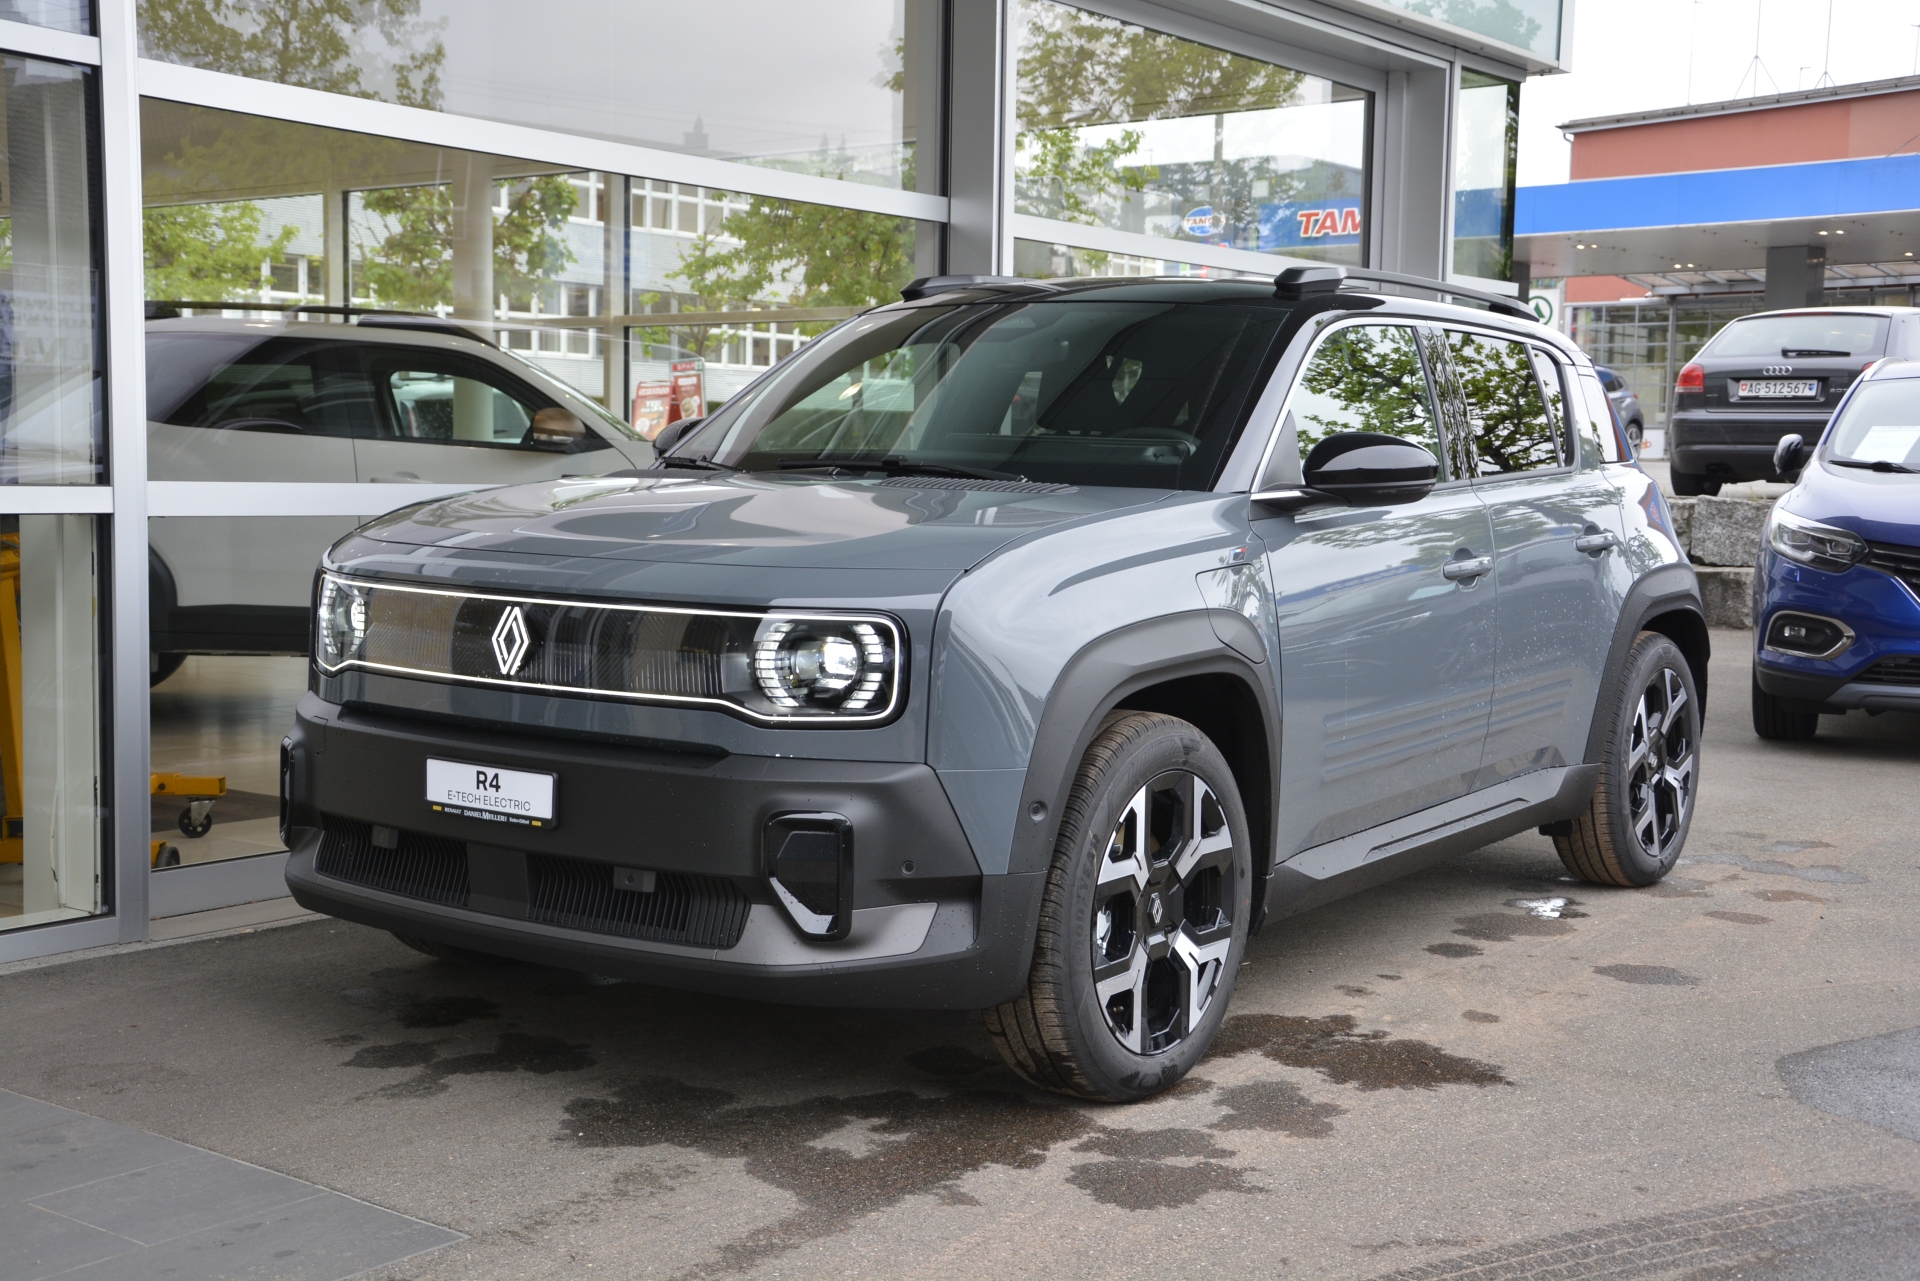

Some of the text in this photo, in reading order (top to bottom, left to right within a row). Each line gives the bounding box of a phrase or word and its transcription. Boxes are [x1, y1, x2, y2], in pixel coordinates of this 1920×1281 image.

[476, 771, 501, 792] R4
[448, 790, 530, 811] E-TECH ELECTRIC
